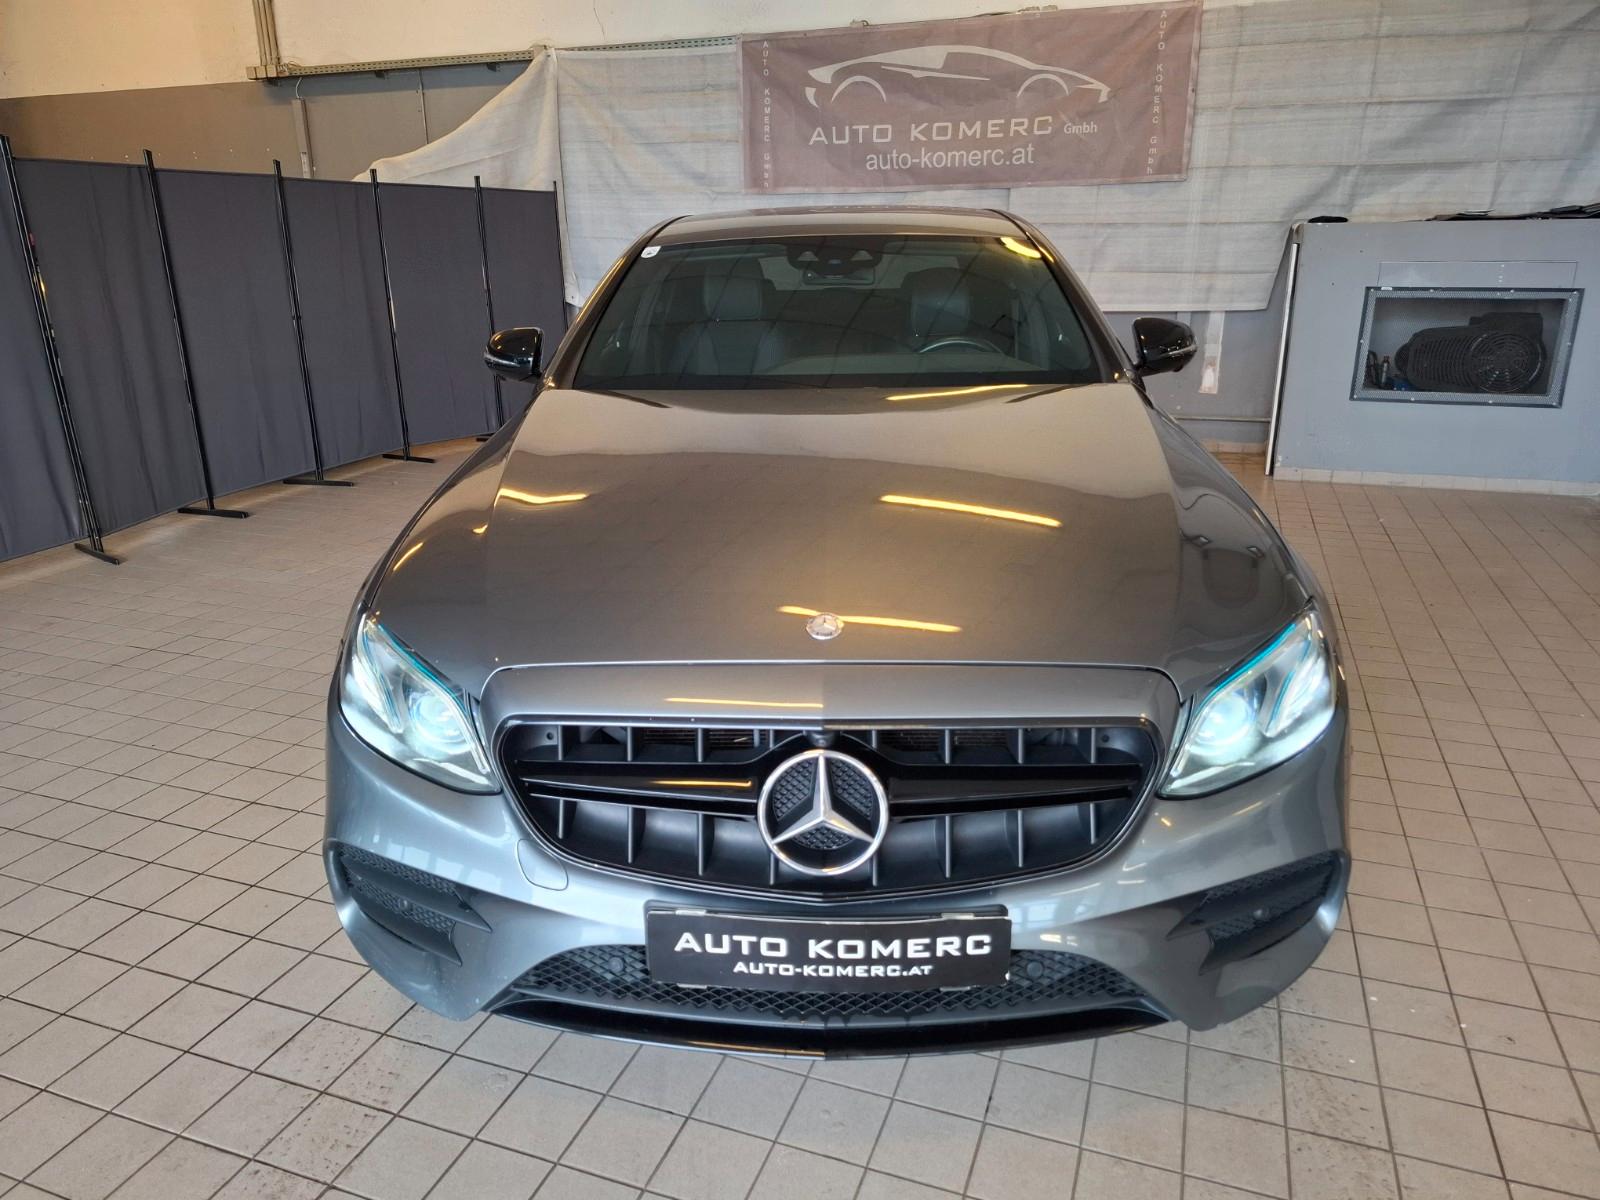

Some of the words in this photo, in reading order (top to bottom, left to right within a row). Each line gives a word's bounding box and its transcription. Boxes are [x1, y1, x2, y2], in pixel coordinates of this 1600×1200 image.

[1158, 10, 1168, 50] AUTO
[762, 40, 771, 76] AUTO
[1152, 63, 1164, 124] KOMERC
[809, 124, 892, 145] AUTO
[910, 115, 1053, 142] KOMERC
[1063, 122, 1098, 134] Gmbh
[865, 143, 1035, 171] auto-komerc.at
[674, 931, 788, 957] AUTO
[808, 934, 993, 960] KOMERC
[733, 961, 934, 977] AUTO-KOMERC.AT
